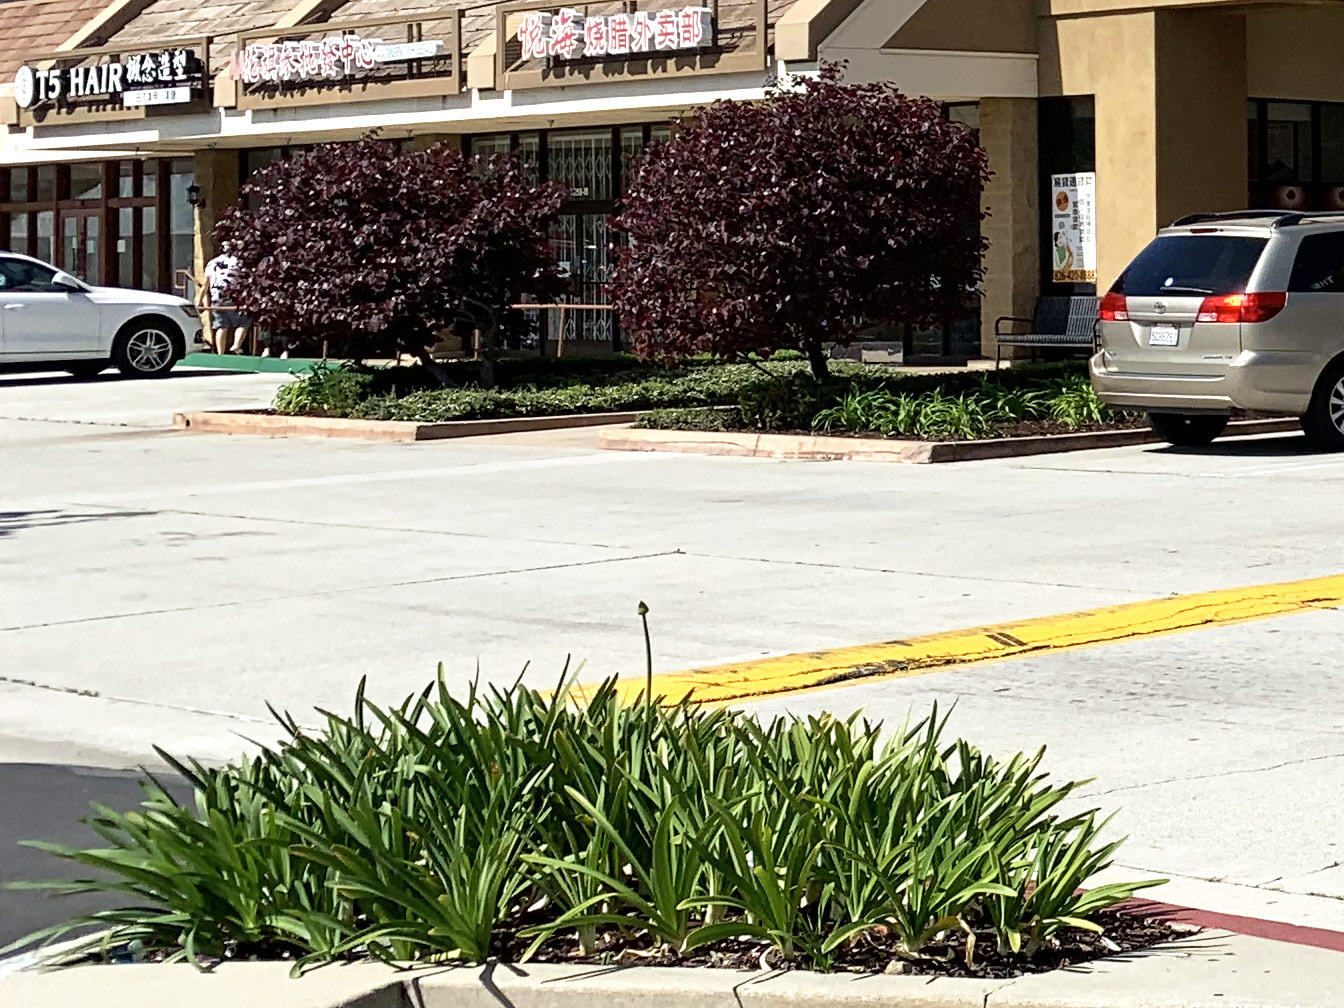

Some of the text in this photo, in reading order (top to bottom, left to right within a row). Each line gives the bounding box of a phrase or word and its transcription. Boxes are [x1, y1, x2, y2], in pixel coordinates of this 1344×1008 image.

[36, 63, 123, 99] T5 HAIR
[126, 50, 188, 83] 概念造型
